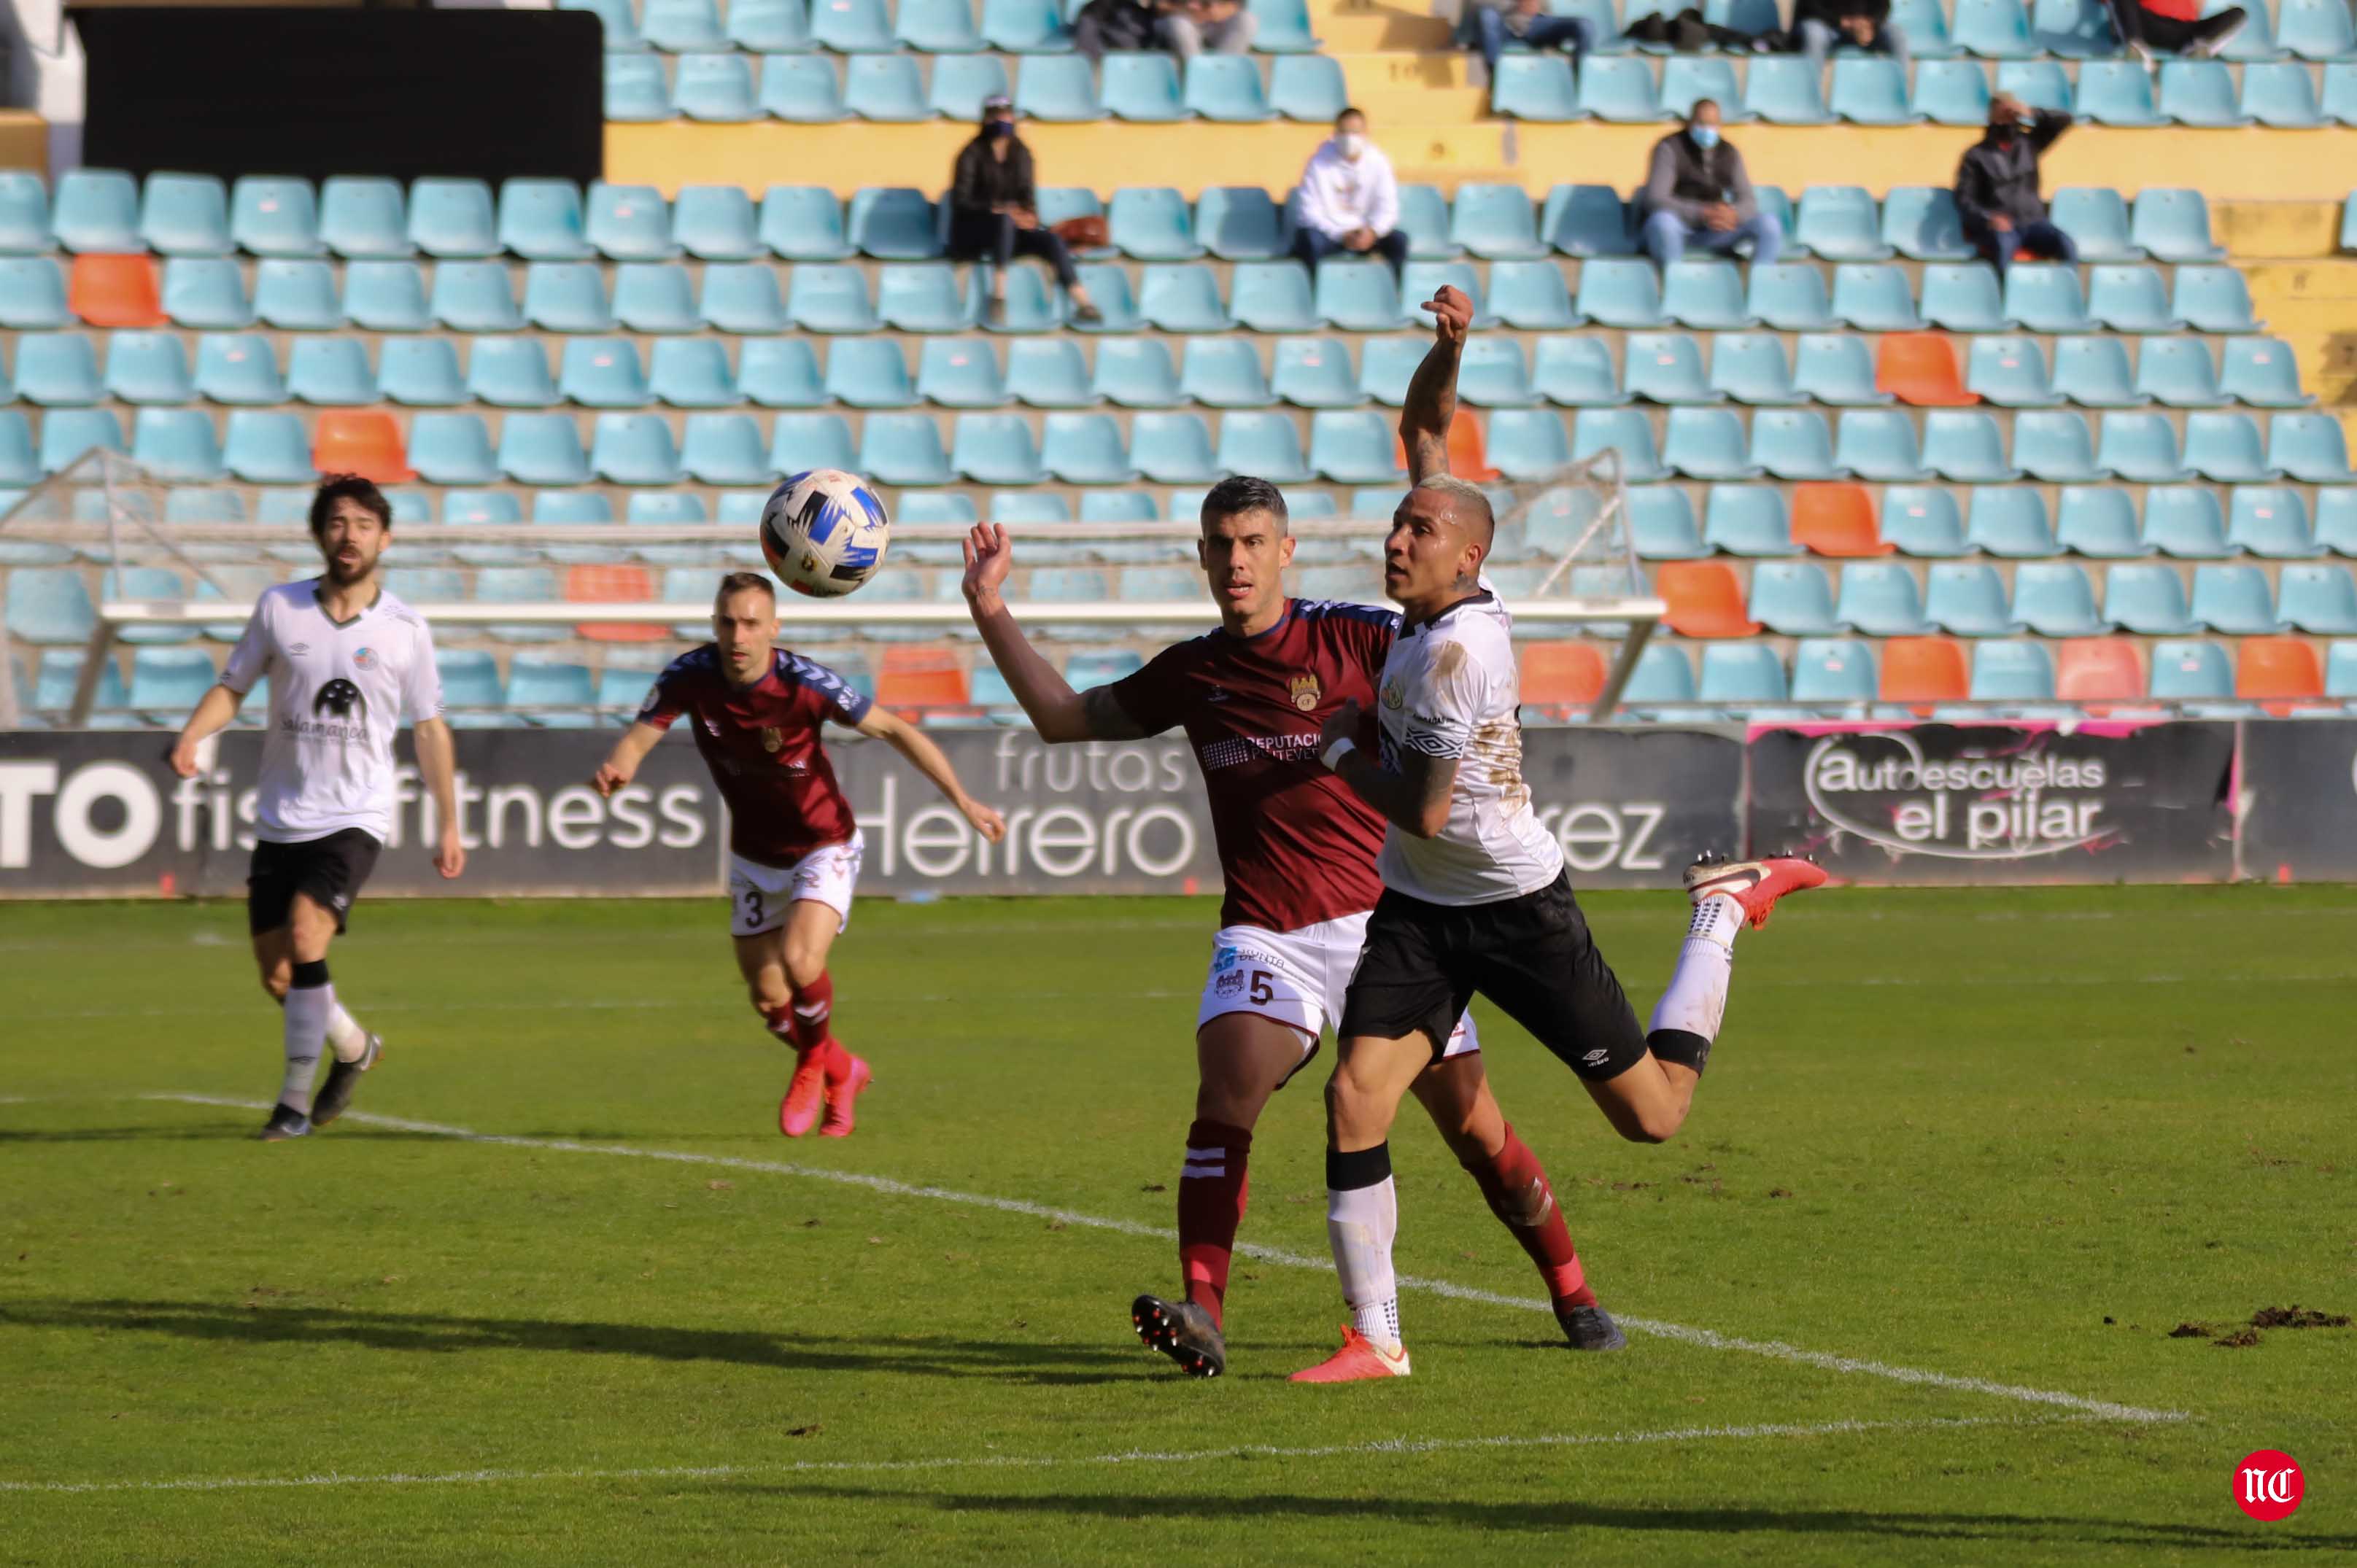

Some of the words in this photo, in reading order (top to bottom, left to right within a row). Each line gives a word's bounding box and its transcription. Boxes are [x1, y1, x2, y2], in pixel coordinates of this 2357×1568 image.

[1247, 733, 1322, 749] EPUTACI
[995, 731, 1188, 793] frutas
[1894, 791, 1946, 841] el
[1968, 790, 2102, 851] pilar
[744, 891, 764, 928] 3
[1249, 969, 1274, 1006] 5
